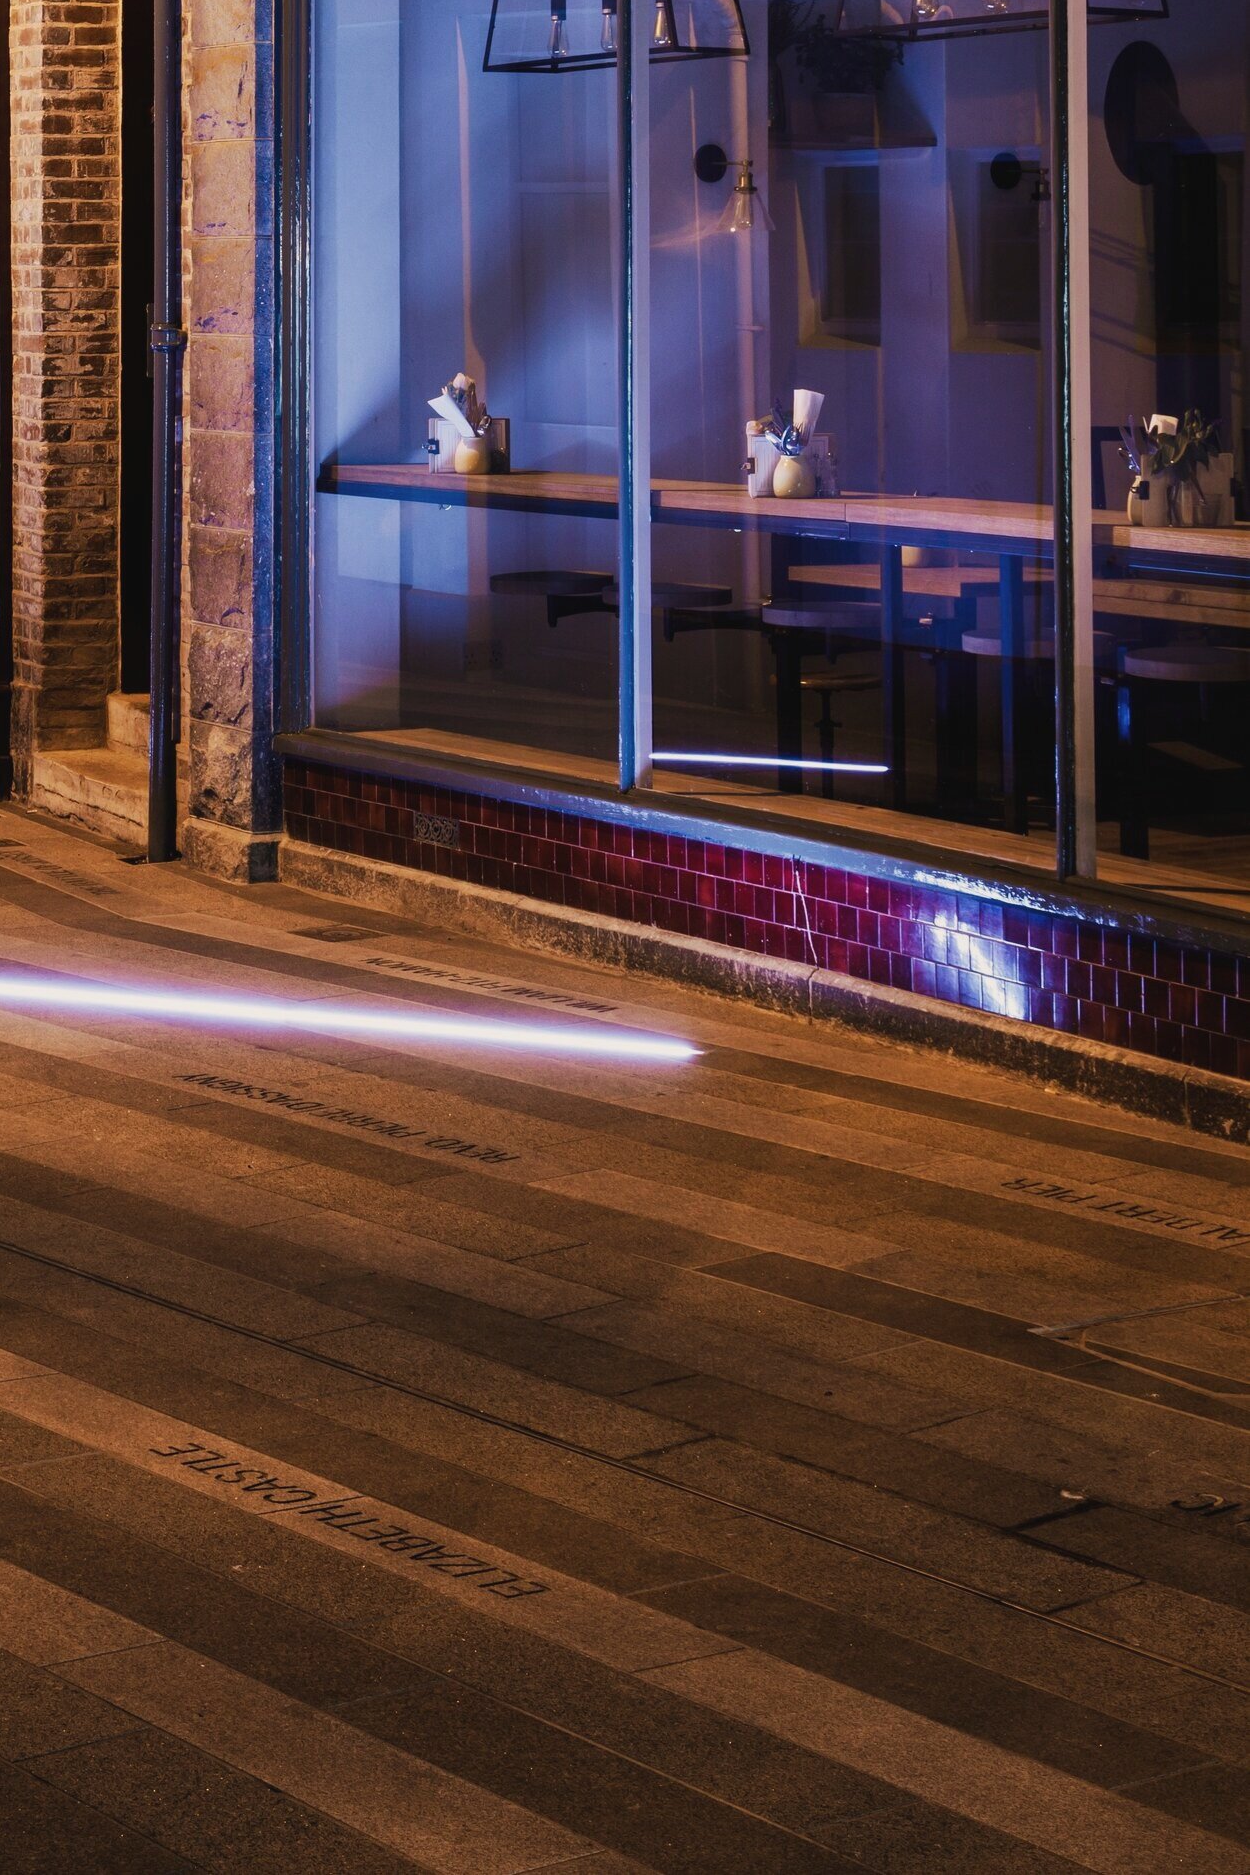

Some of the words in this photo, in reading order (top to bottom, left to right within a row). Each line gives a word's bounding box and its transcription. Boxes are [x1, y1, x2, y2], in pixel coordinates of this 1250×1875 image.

[318, 1105, 426, 1139] PIERRE
[999, 1176, 1098, 1205] PIER
[1086, 1201, 1250, 1242] ALBERT
[145, 1440, 320, 1507] CASTLE
[310, 1500, 550, 1602] ELIZABETH
